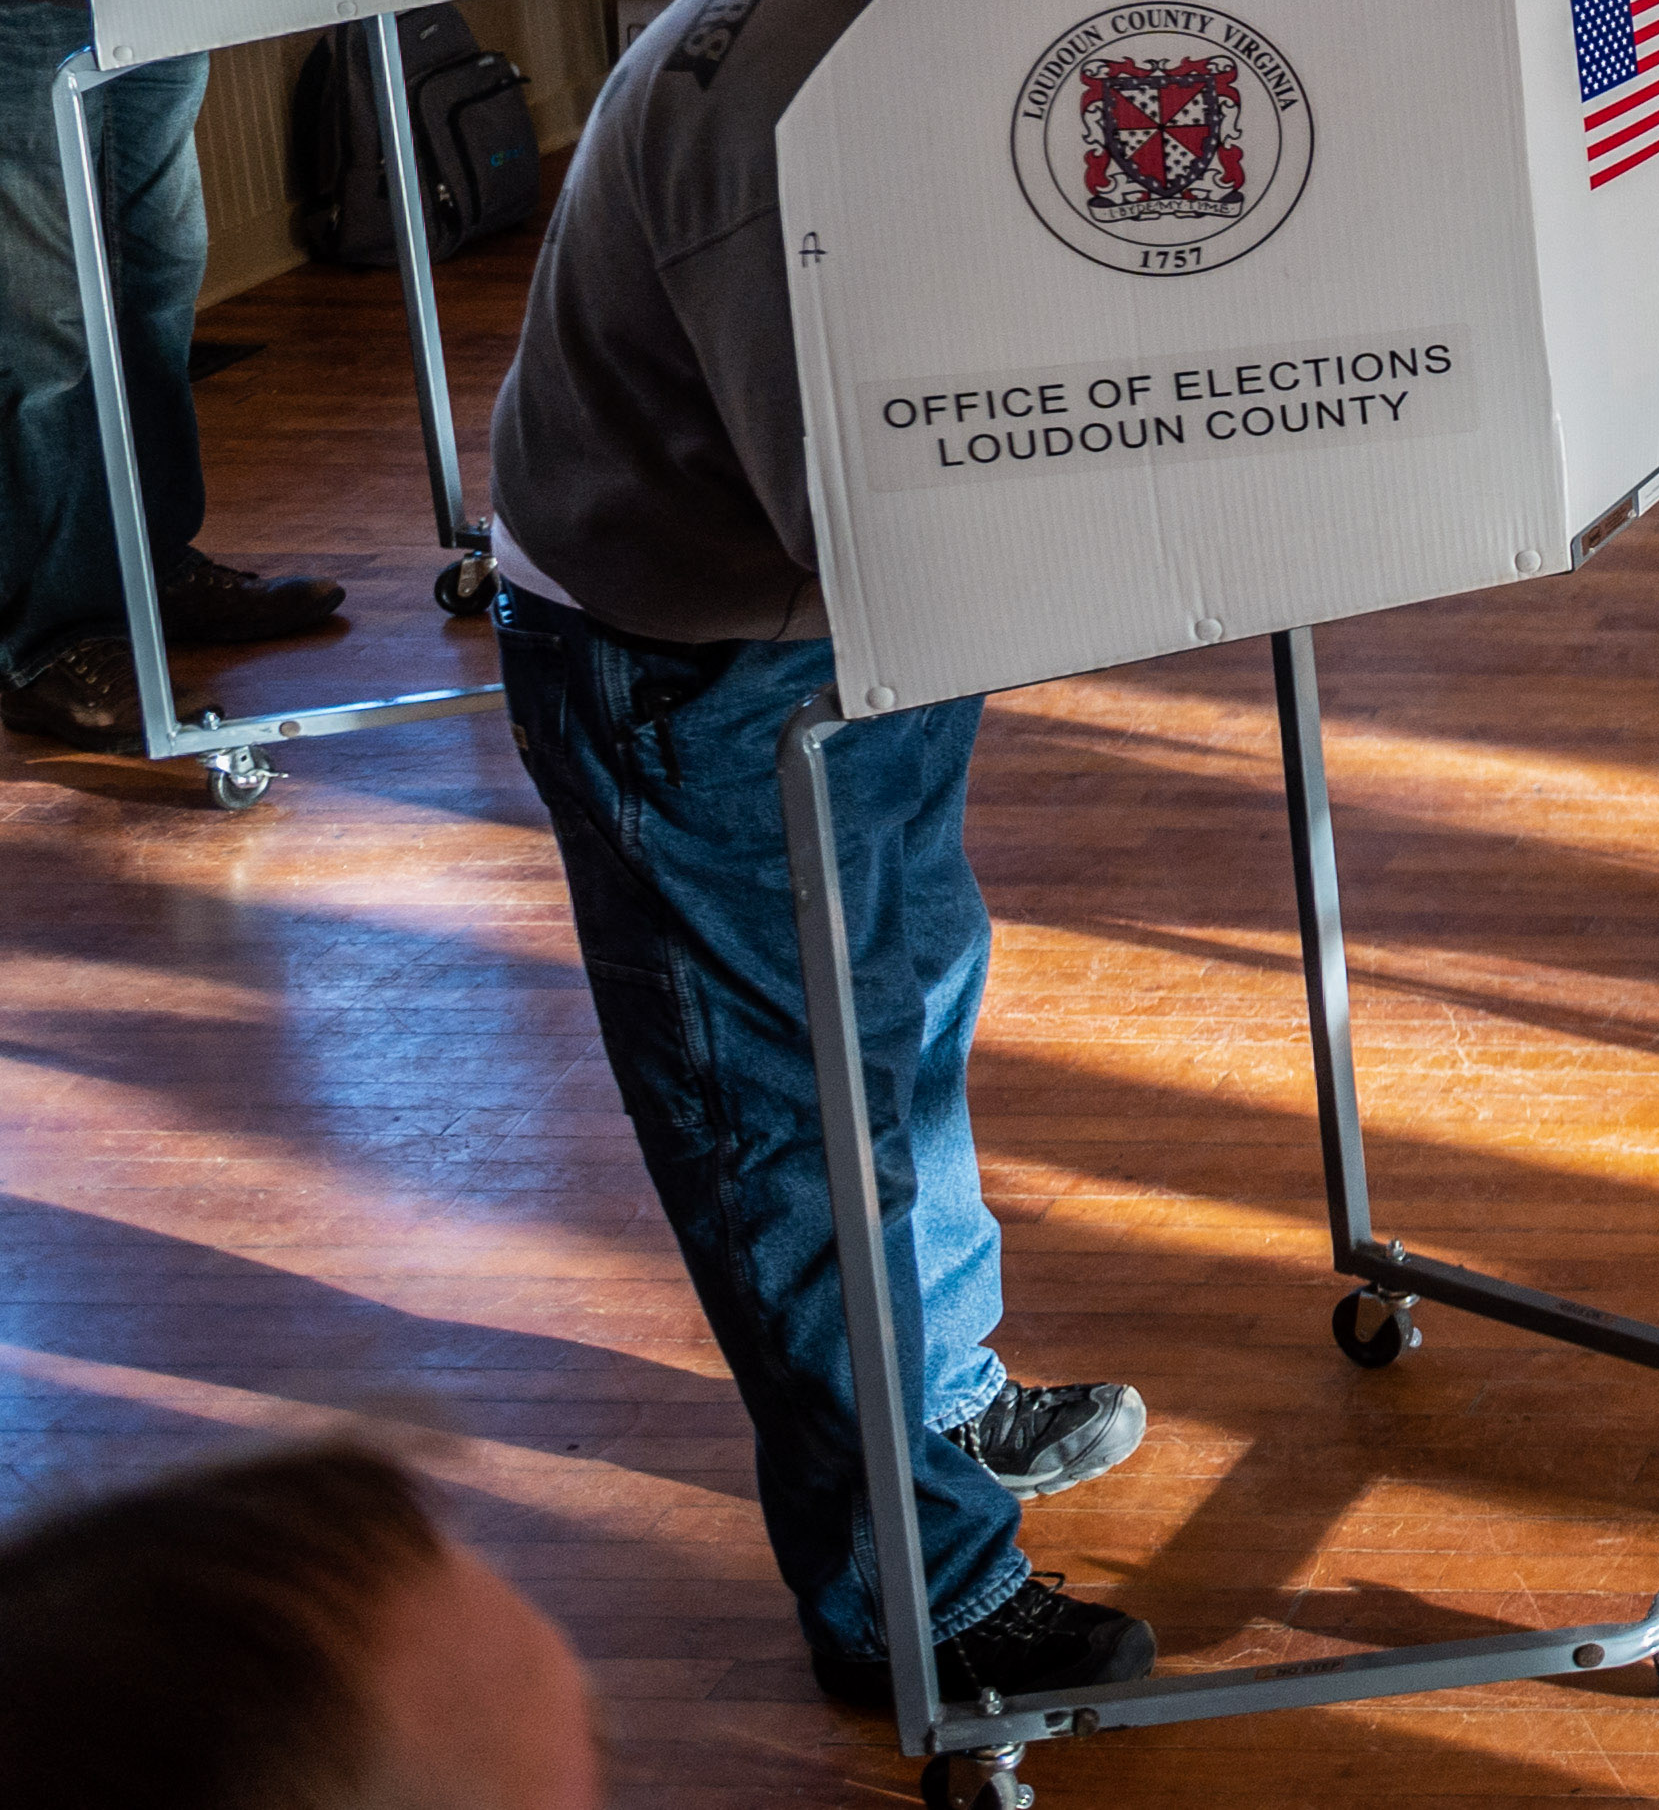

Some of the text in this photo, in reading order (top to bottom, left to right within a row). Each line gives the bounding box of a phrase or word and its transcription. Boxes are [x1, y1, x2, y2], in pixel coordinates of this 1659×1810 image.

[1023, 9, 1299, 120] LOUDOUN COUNTY VIRGINIA
[1140, 247, 1203, 269] 1757
[883, 344, 1453, 428] OFFICE OF ELECTIONS
[938, 391, 1409, 467] LOUDOUN COUNTY
